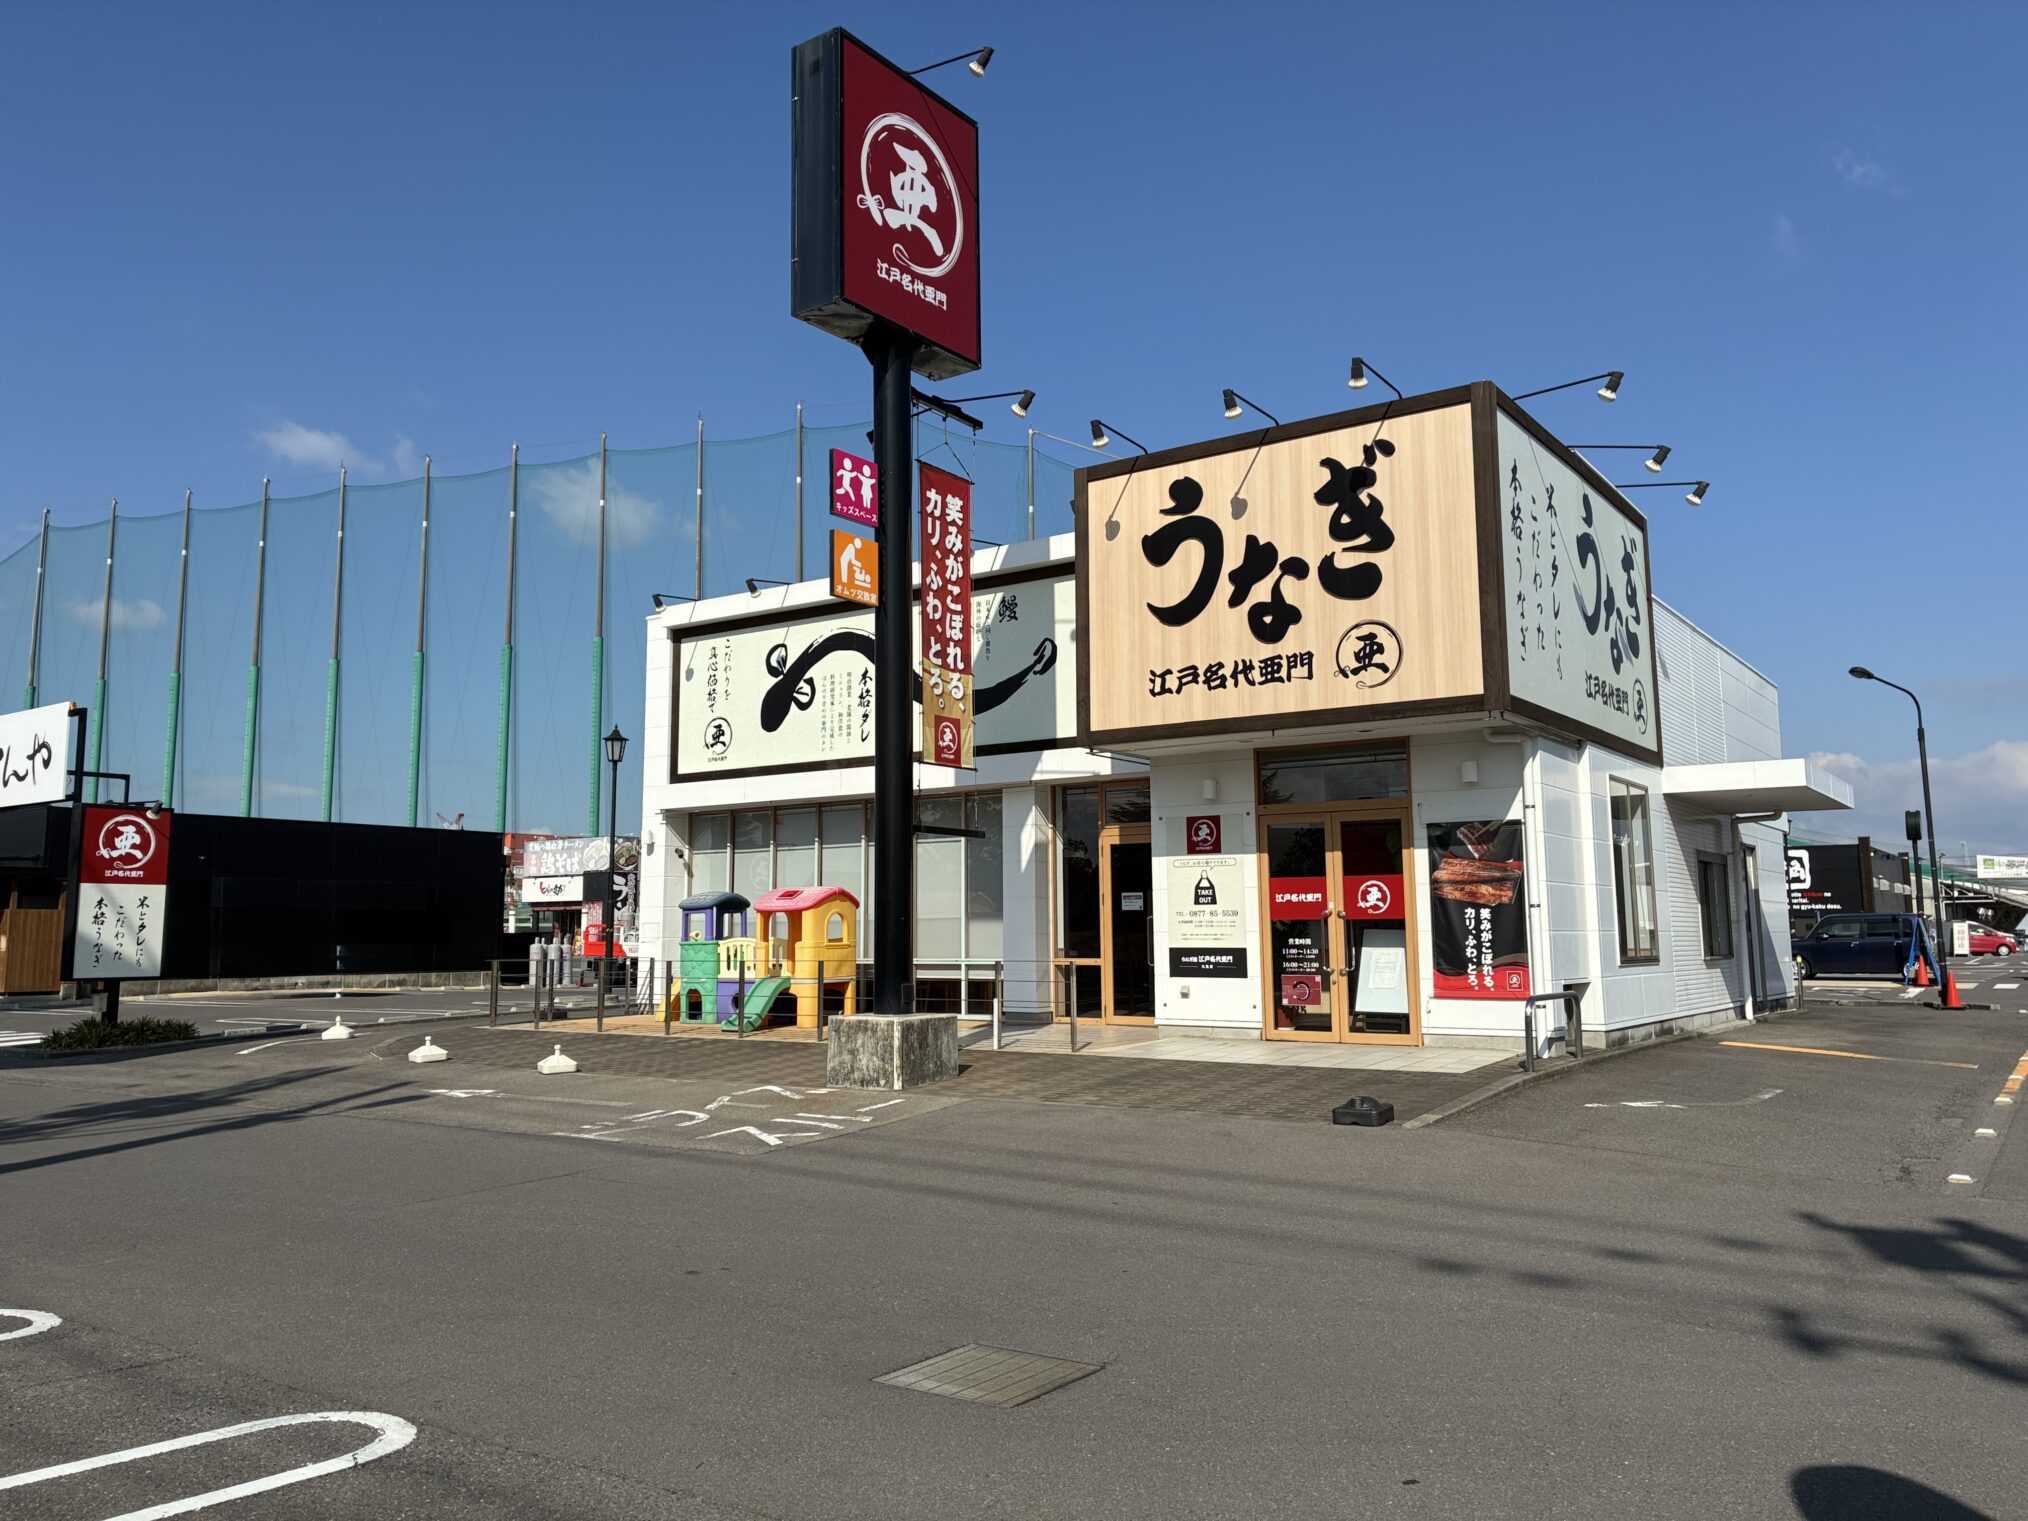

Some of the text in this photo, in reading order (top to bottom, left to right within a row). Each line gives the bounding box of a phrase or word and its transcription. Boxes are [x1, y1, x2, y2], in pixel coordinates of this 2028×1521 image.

[876, 258, 948, 311] 江戸名代亜門
[835, 502, 878, 523] キッズスペース
[1141, 438, 1397, 644] うなぎ
[1509, 457, 1528, 662] 本格うなぎ
[1529, 495, 1546, 651] こだわった
[1575, 492, 1641, 676] うなぎ
[836, 584, 877, 604] オムツ交換室
[723, 639, 733, 700] こだわりを
[1148, 650, 1314, 698] 江戸名代亜門
[0, 729, 52, 788] んや
[91, 896, 108, 968] 本格うなぎ
[112, 904, 126, 961] こだわった
